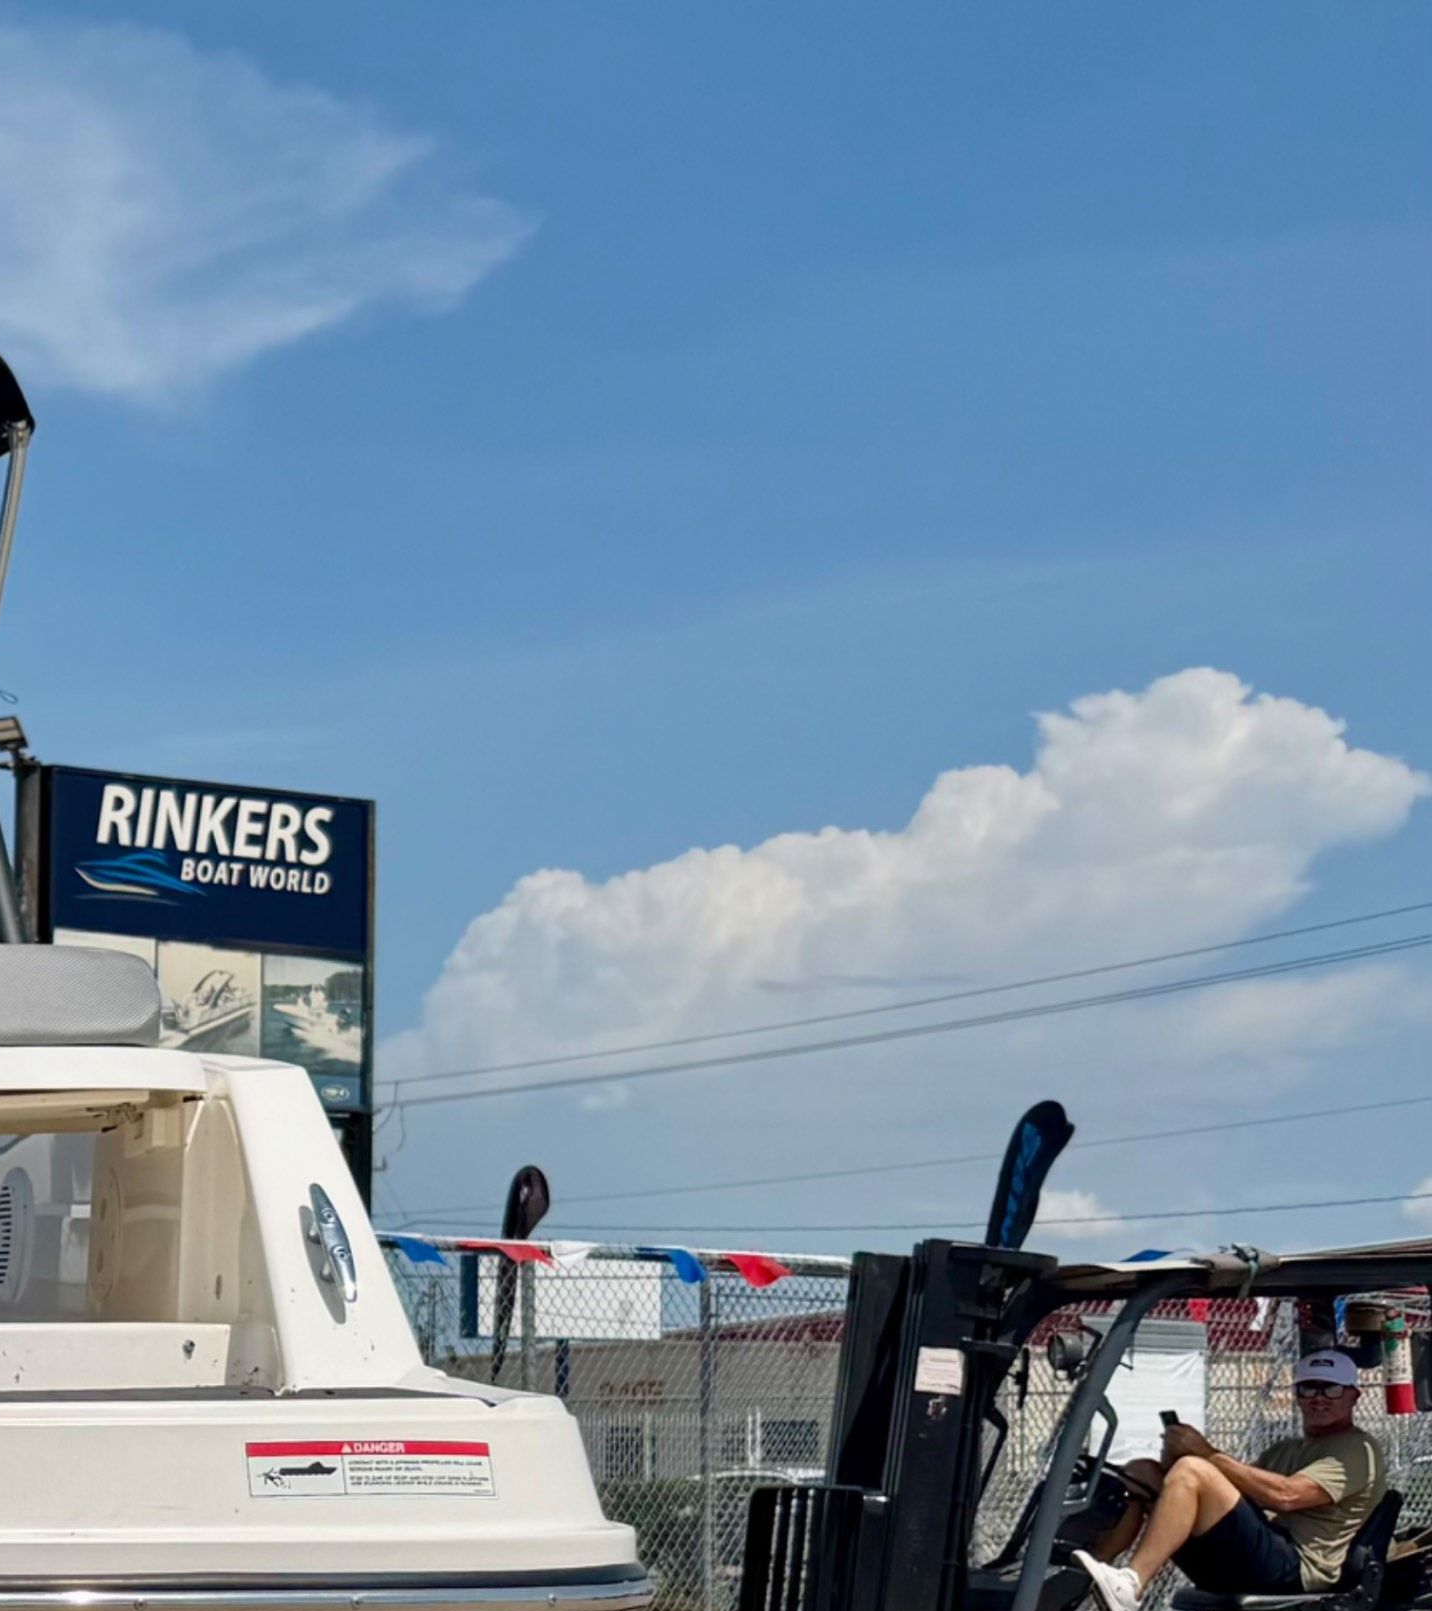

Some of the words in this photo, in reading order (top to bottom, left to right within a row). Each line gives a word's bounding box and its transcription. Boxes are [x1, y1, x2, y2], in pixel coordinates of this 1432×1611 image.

[96, 782, 334, 866] RINKERS
[180, 857, 243, 886] BOAT
[249, 865, 332, 895] WORLD
[353, 1442, 406, 1453] DANGER
